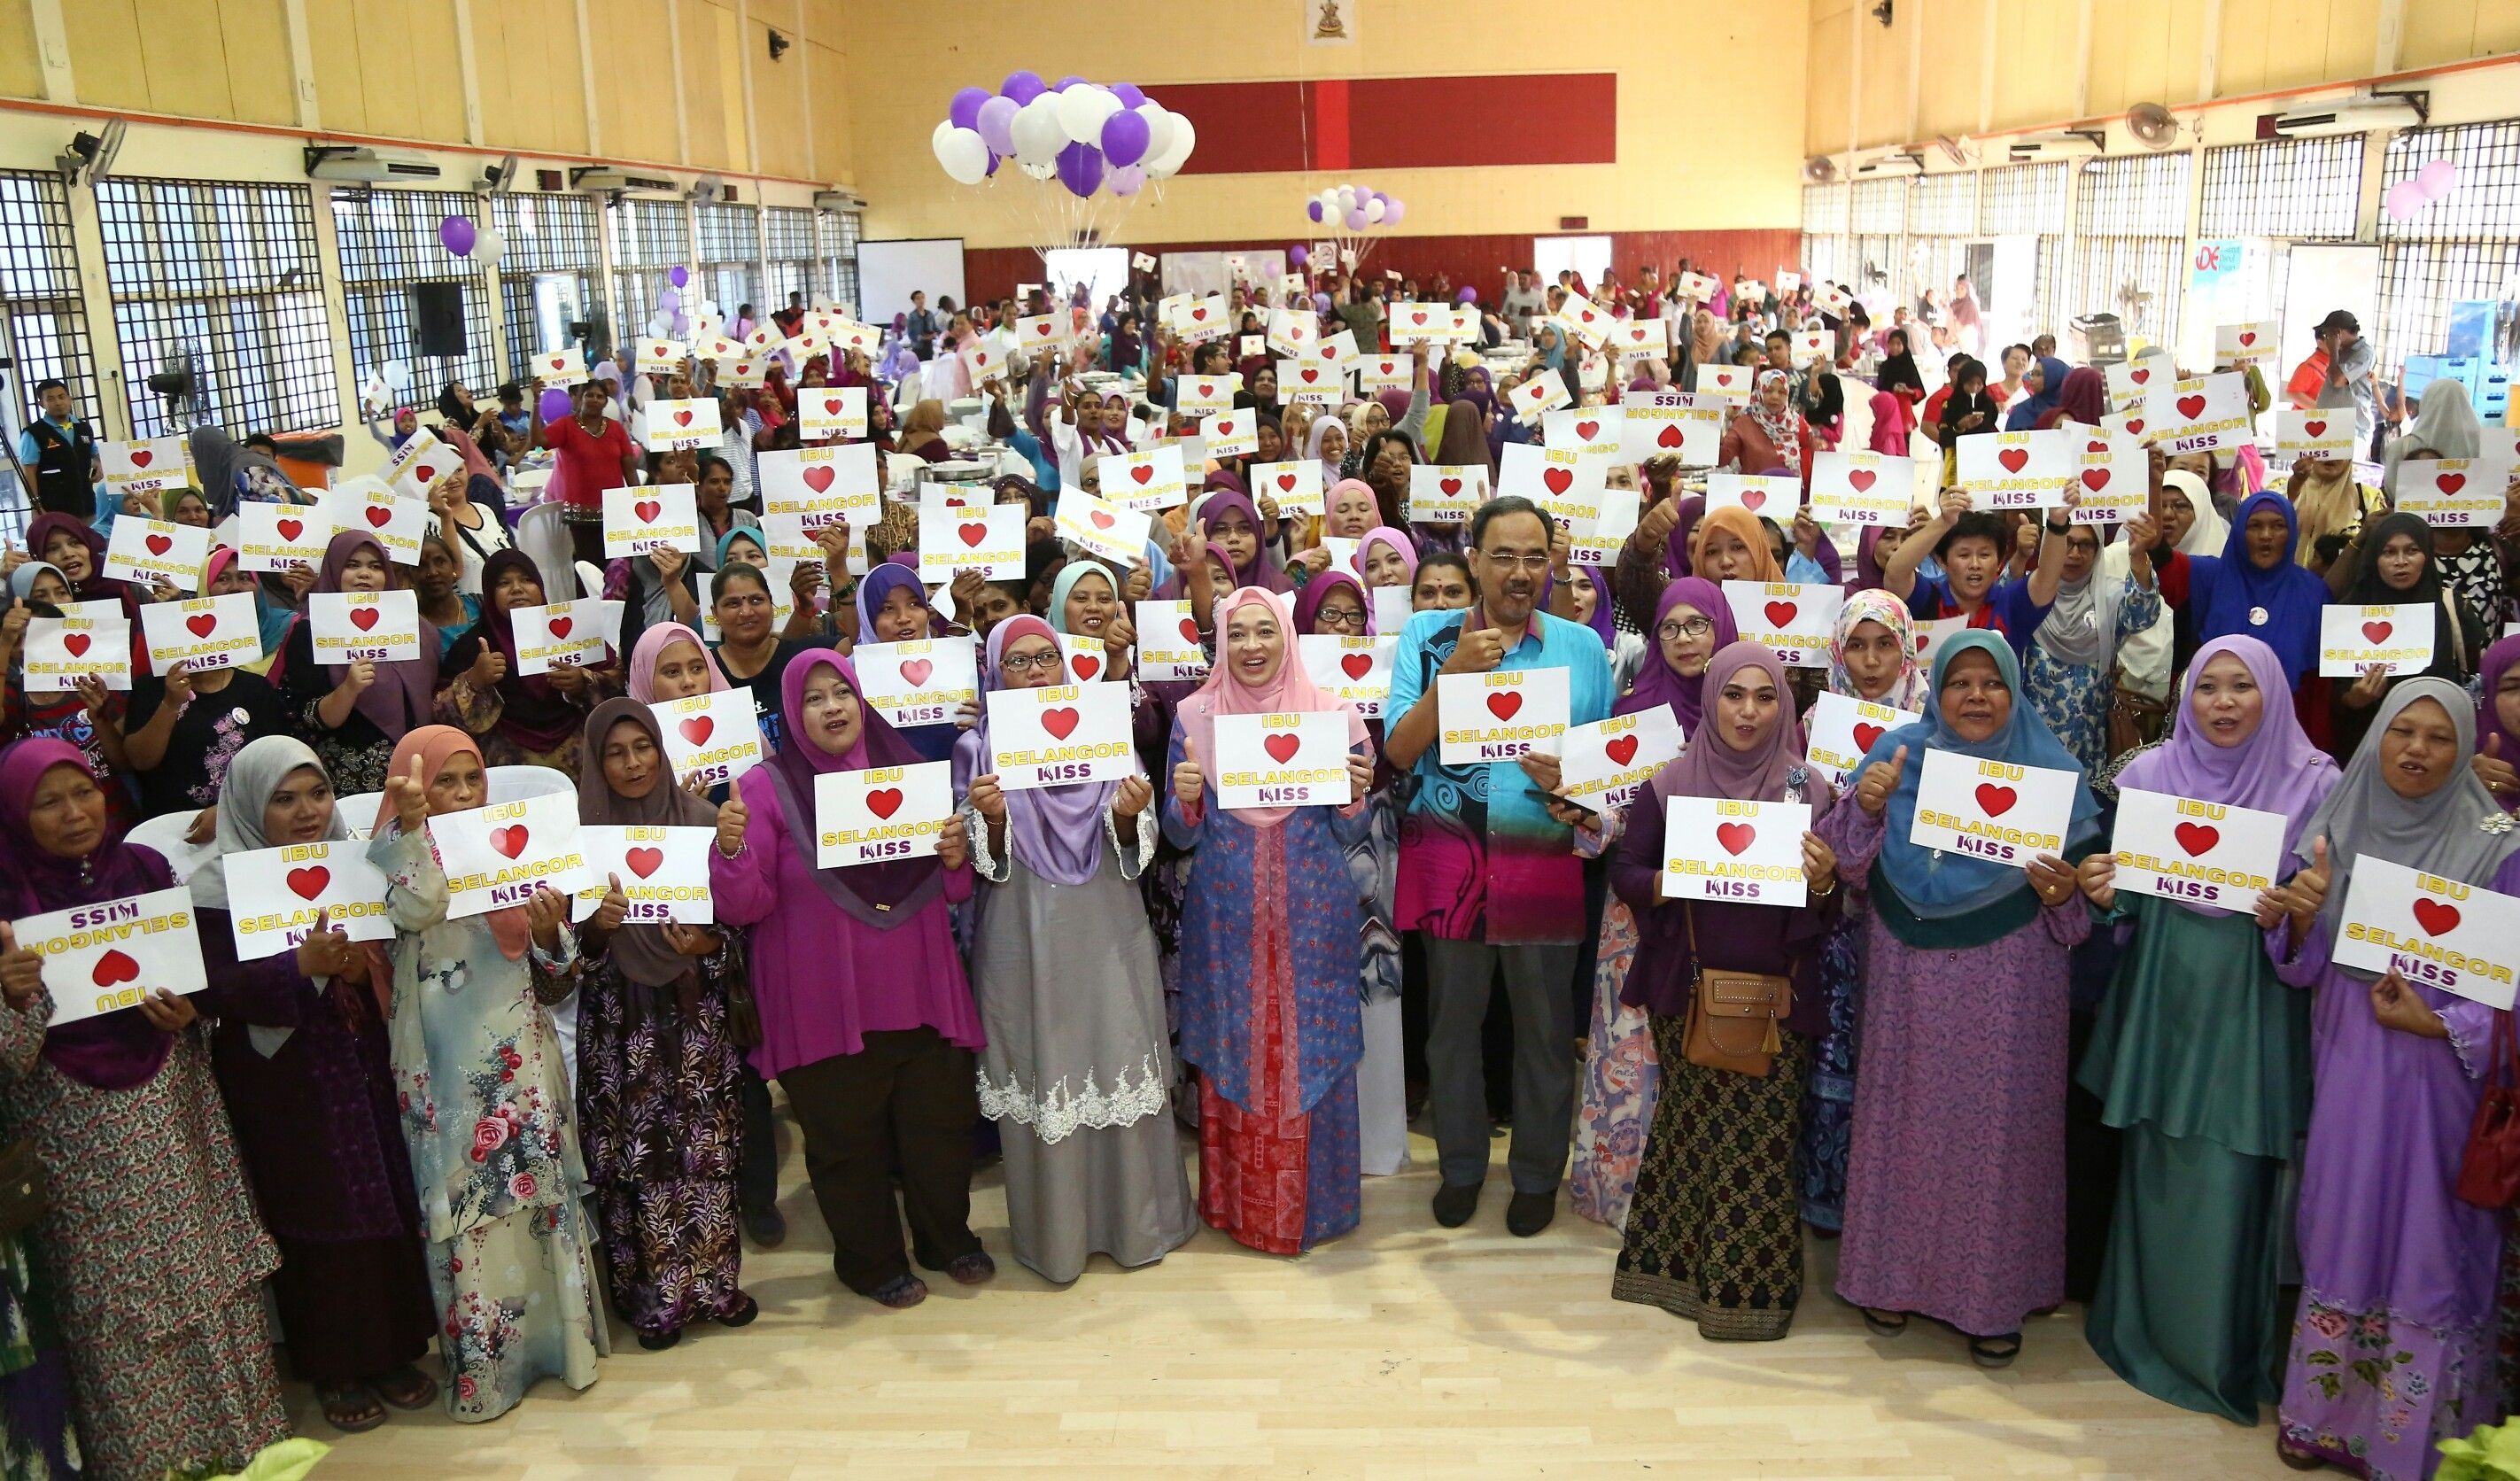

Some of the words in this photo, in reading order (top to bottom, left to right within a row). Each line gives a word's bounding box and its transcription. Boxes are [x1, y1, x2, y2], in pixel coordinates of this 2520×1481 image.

[1192, 329, 1215, 339] KISS
[1281, 345, 1299, 357] KISS
[2128, 360, 2149, 368] IBU
[823, 388, 843, 397] IBU
[1280, 385, 1341, 394] SELANGOR
[2173, 380, 2205, 392] IBU
[1655, 395, 1694, 406] KISS
[1194, 407, 1215, 416] KISS
[1572, 409, 1598, 419] IBU
[1626, 407, 1718, 421] SELANGOR
[2306, 410, 2329, 419] IBU
[803, 417, 865, 426] SELANGOR
[651, 427, 719, 439] SELANGOR
[2090, 427, 2112, 439] IBU
[2149, 418, 2247, 442] SELANGOR
[1998, 433, 2029, 444] IBU
[2175, 434, 2219, 451] KISS
[2278, 439, 2353, 449] SELANGOR
[393, 445, 414, 464] KISS
[800, 450, 834, 461] IBU
[1128, 454, 1151, 462] IBU
[1216, 446, 1239, 456] KISS
[1546, 450, 1578, 464] IBU
[1850, 454, 1880, 466] IBU
[2082, 454, 2112, 464] IBU
[2438, 460, 2469, 469] IBU
[1276, 462, 1296, 471] IBU
[107, 467, 184, 483] SELANGOR
[1743, 477, 1769, 486] IBU
[130, 481, 162, 491] KISS
[633, 487, 659, 497] IBU
[946, 486, 965, 495] IBU
[1105, 483, 1182, 500] SELANGOR
[1963, 478, 2068, 492] SELANGOR
[368, 492, 395, 505] IBU
[768, 493, 876, 514] SELANGOR
[1129, 496, 1160, 508] KISS
[1278, 492, 1322, 507] ANGOR
[1813, 493, 1908, 510] SELANGOR
[1992, 492, 2036, 504] KISS
[276, 505, 302, 515] IBU
[2400, 500, 2501, 511] SELANGOR
[802, 511, 847, 526] KISS
[958, 508, 988, 518] IBU
[1434, 508, 1465, 519] KISS
[1839, 510, 1877, 522] KISS
[2075, 508, 2117, 521] KISS
[2427, 512, 2469, 524] KISS
[148, 521, 175, 532] IBU
[606, 525, 695, 542] SELANGOR
[242, 544, 326, 557] SELANGOR
[633, 539, 671, 553] KISS
[1079, 535, 1112, 552] KISS
[924, 551, 1021, 565] SELANGOR
[109, 553, 200, 578] SELANGOR
[1765, 584, 1801, 596] IBU
[182, 600, 213, 610] IBU
[348, 593, 379, 603] IBU
[547, 603, 571, 616] IBU
[2363, 607, 2394, 616] IBU
[63, 619, 91, 629] IBU
[1914, 623, 1934, 632] BU
[315, 633, 415, 647] SELANGOR
[1072, 637, 1103, 651] IBU
[1341, 638, 1375, 648] IBU
[151, 637, 256, 660] SELANGOR
[519, 638, 601, 660] SELANGOR
[897, 641, 931, 654] IBU
[2324, 648, 2430, 661] SELANGOR
[186, 654, 229, 671] KISS
[347, 649, 388, 662] KISS
[1143, 653, 1205, 663] SELAN
[27, 663, 125, 673] SELANGOR
[1485, 673, 1523, 686] IBU
[865, 688, 975, 709] SELANGOR
[1038, 687, 1078, 702] IBU
[674, 696, 710, 712] IBU
[898, 707, 944, 722] KISS
[1858, 703, 1896, 721] IBU
[1263, 715, 1299, 727] IBU
[1601, 716, 1636, 734] IBU
[1446, 728, 1564, 749] SELANGOR
[673, 741, 757, 769] LANGOR
[997, 742, 1128, 767] SELANGOR
[1481, 742, 1531, 757] KISS
[1810, 750, 1861, 769] SELA
[865, 769, 903, 783] IBU
[1038, 764, 1092, 780] KISS
[1980, 761, 2024, 780] IBU
[1221, 769, 1345, 787] SELANGOR
[1257, 787, 1309, 801] KISS
[484, 802, 526, 822] IBU
[1717, 802, 1757, 817] IBU
[2178, 800, 2226, 820] IBU
[626, 827, 665, 840] IBU
[1920, 810, 2060, 850] SELANGOR
[283, 845, 328, 862] IBU
[860, 841, 911, 858] KISS
[1957, 836, 2013, 859] KISS
[446, 854, 582, 893] SELANGOR
[1669, 858, 1803, 882] SELANGOR
[2116, 851, 2268, 891] SELANGOR
[492, 880, 550, 904] KISS
[1705, 880, 1760, 898] KISS
[2156, 878, 2218, 901] KISS
[2418, 873, 2470, 900] IBU
[71, 903, 139, 928] KISS
[2346, 923, 2514, 983] SELANGOR
[2389, 953, 2456, 987] KISS
[97, 988, 146, 1012] IBU
